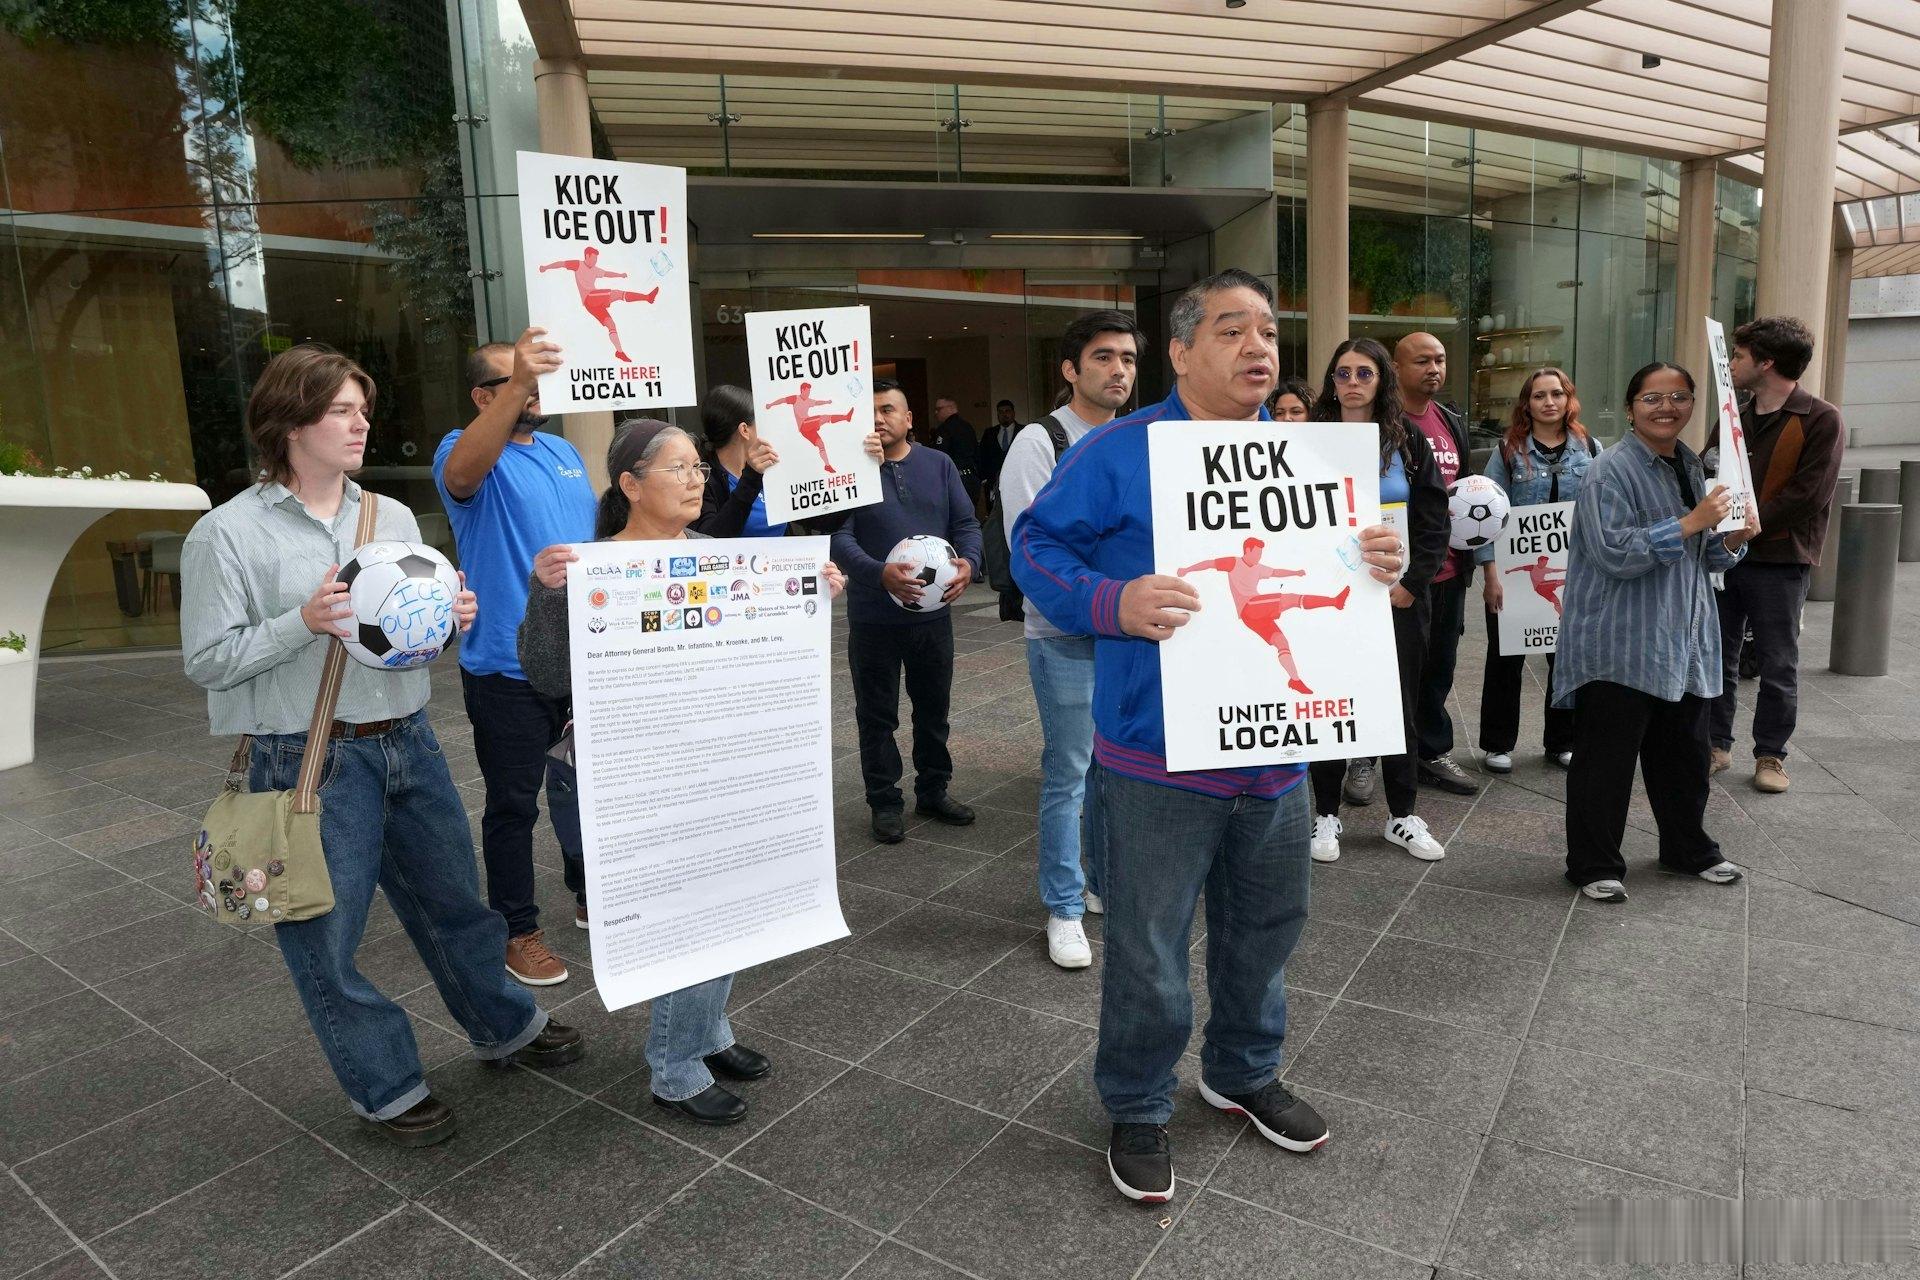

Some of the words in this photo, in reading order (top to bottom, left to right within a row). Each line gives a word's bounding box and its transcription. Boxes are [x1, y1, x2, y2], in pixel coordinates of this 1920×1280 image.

[555, 174, 622, 205] KICK
[543, 208, 589, 241] ICE
[594, 206, 667, 244] OUT!
[717, 305, 753, 324] 63
[775, 320, 827, 352] KICK
[768, 354, 804, 381] ICE
[808, 340, 859, 379] OUT!
[570, 367, 615, 382] UNITE
[620, 366, 661, 380] HERE!
[571, 382, 636, 401] LOCAL
[645, 381, 662, 397] 11
[1202, 440, 1294, 485] KICK
[790, 479, 825, 495] UNITE
[827, 473, 856, 489] HERE!
[791, 489, 840, 511] LOCAL
[845, 485, 858, 500] 11
[1186, 490, 1251, 531] ICE
[1259, 477, 1357, 532] OUT!
[1518, 510, 1567, 535] KICK
[1510, 536, 1542, 555] ICE
[587, 566, 622, 575] LCLAA
[625, 569, 643, 579] EPIC
[771, 564, 793, 572] POLICY
[793, 563, 816, 571] CENTER
[394, 583, 444, 609] ICE
[643, 590, 662, 600] KIWA
[730, 593, 750, 602] JMA
[382, 608, 427, 634] OUT
[1524, 626, 1558, 637] UNITE
[587, 651, 603, 659] Dear
[604, 648, 631, 659] Attorney
[632, 646, 656, 656] General
[656, 645, 676, 654] Bonta,
[677, 643, 687, 651] Mr.
[688, 641, 715, 651] Infantino,
[715, 640, 725, 648] Mr.
[725, 638, 750, 647] Kroenke,
[750, 636, 761, 645] and
[1524, 635, 1558, 648] LOC
[1218, 702, 1287, 725] UNITE
[1295, 698, 1354, 720] HERE!
[1219, 722, 1319, 751] LOCAL
[1332, 719, 1357, 743] 11
